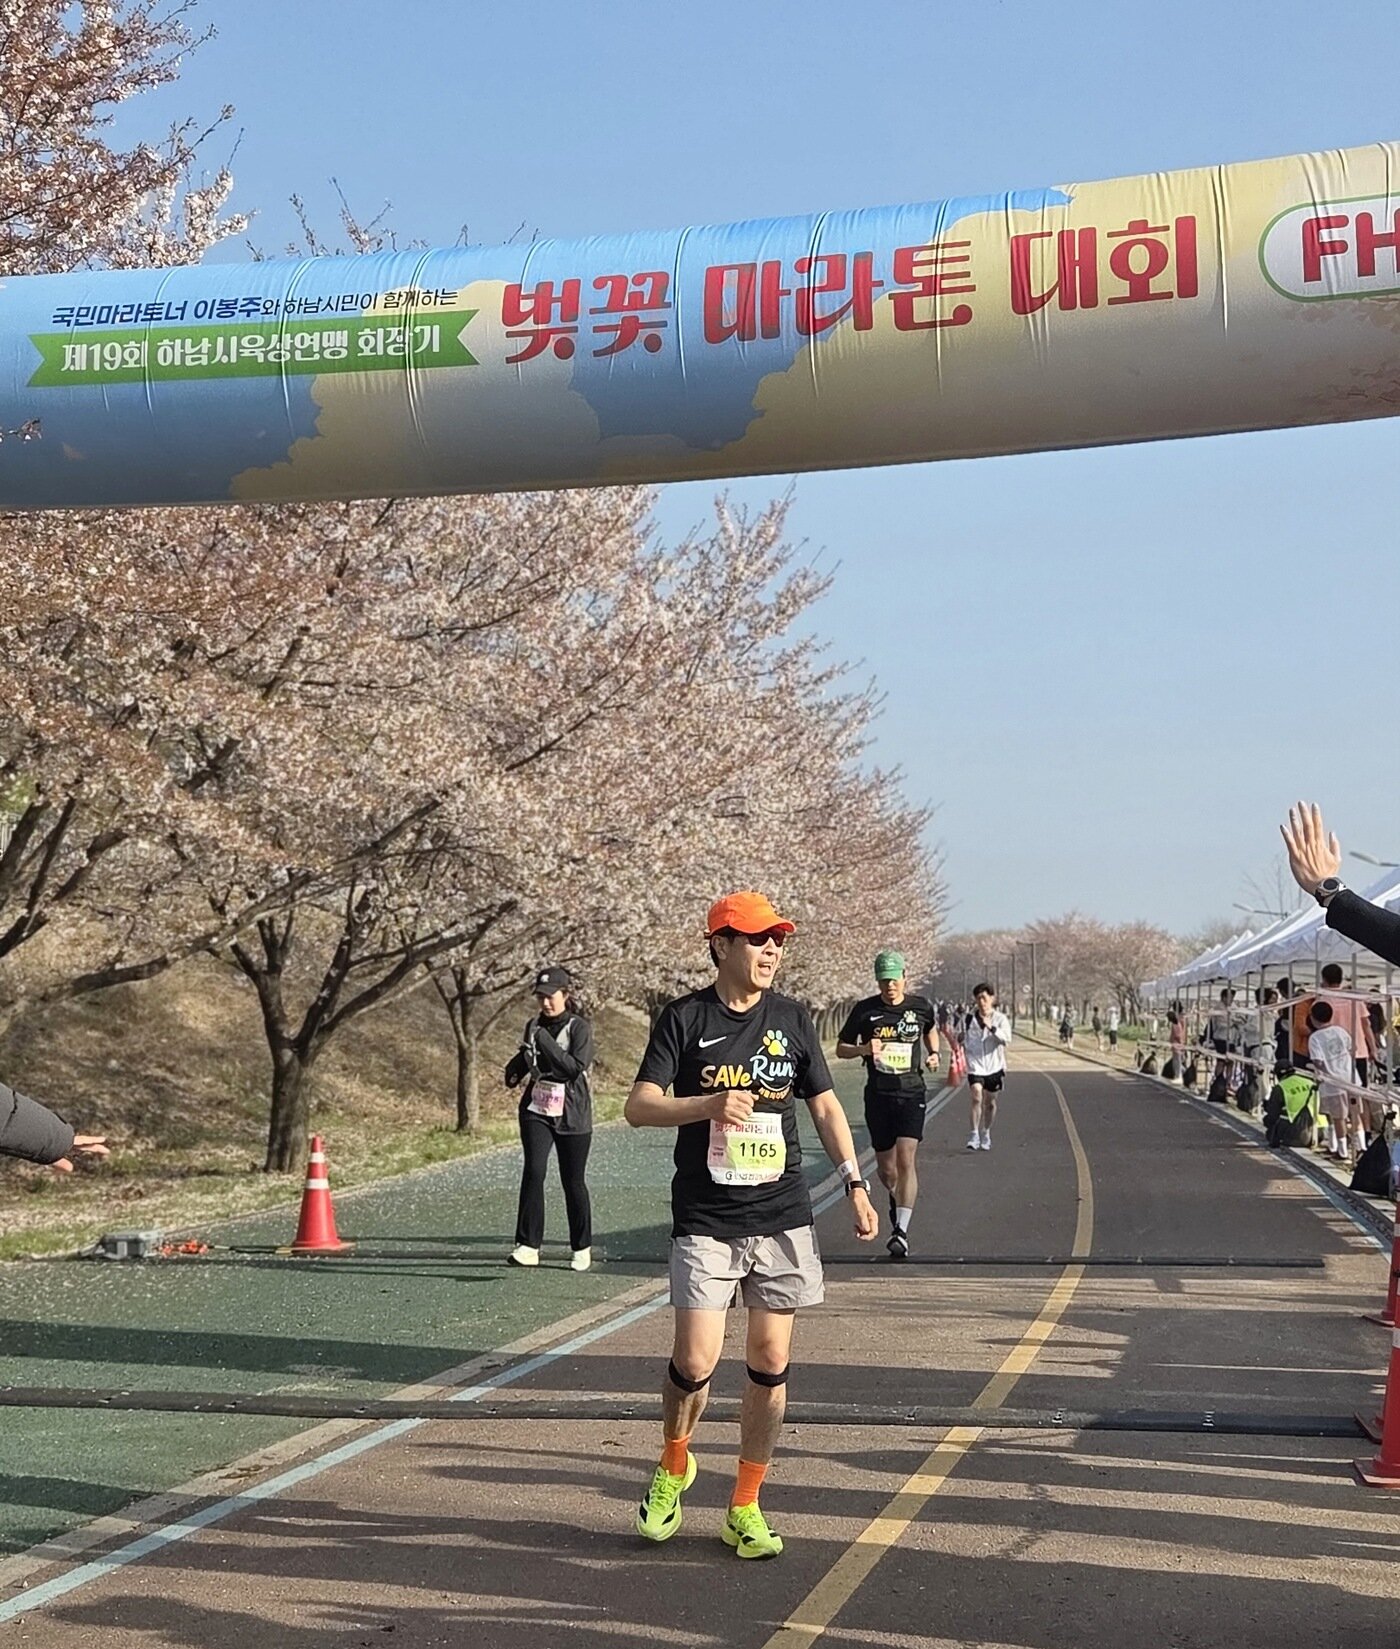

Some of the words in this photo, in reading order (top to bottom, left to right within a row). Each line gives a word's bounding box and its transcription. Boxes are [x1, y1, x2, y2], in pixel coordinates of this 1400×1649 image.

[52, 301, 188, 327] 국민마라토너
[285, 292, 378, 314] 하남시민이
[383, 288, 458, 310] 함께하는
[501, 271, 672, 364] 벚꽃
[703, 240, 977, 344] 마라톤
[1011, 215, 1198, 315] 대회
[61, 340, 149, 372] 제19회
[157, 330, 348, 367] 하남시육상연맹
[357, 324, 440, 358] 회장기
[897, 1020, 920, 1035] Run
[700, 1064, 753, 1088] SAVe
[750, 1054, 795, 1082] Run
[740, 1142, 777, 1158] 1165
